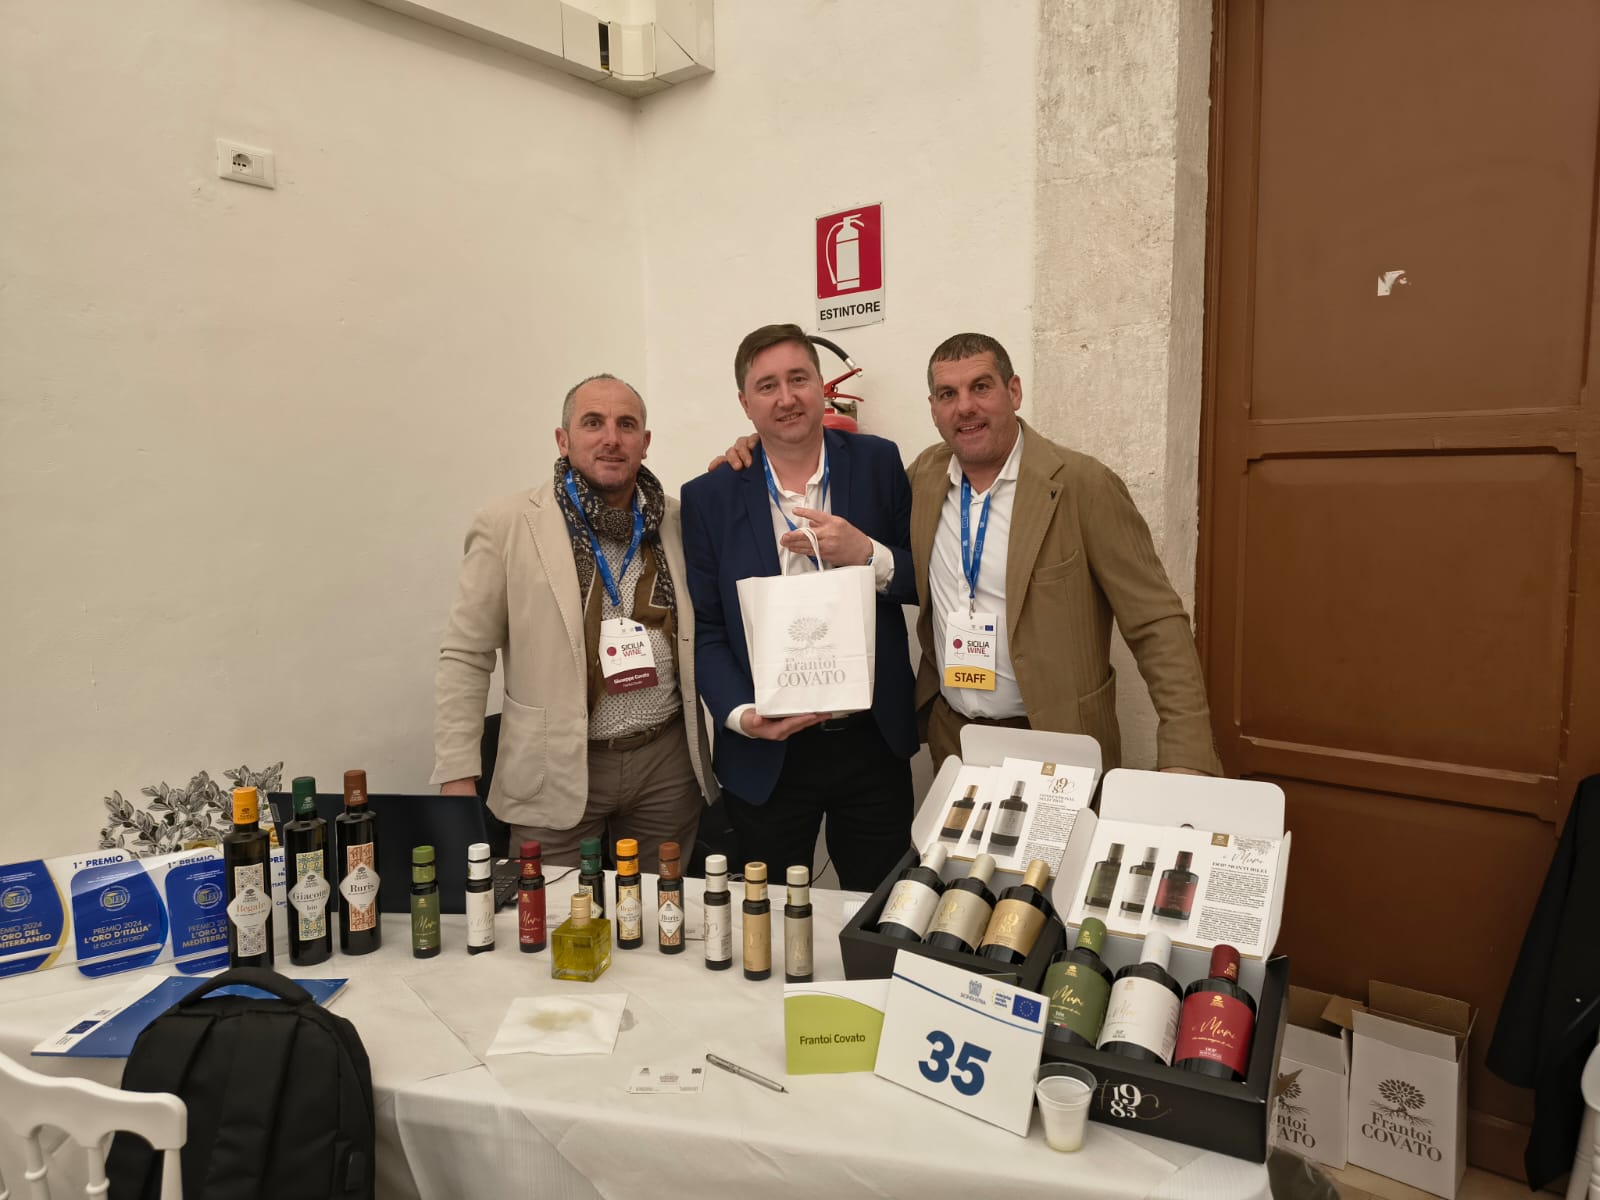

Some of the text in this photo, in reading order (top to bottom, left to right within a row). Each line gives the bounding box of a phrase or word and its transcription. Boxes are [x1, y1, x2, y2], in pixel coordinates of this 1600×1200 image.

[820, 301, 880, 321] ESTINTORE
[621, 641, 645, 651] SICILIA
[966, 640, 990, 648] SICILIA
[623, 649, 642, 657] WINE
[967, 647, 986, 655] WINE
[785, 655, 837, 671] Frantoi
[777, 669, 846, 687] COVATO
[954, 672, 987, 684] STAFF
[85, 855, 123, 867] PREMIO
[179, 854, 215, 865] PREMIO
[0, 921, 43, 934] EMIO 2024
[93, 920, 142, 934] PREMIO 2024
[188, 919, 226, 932] PREMIO 20
[25, 929, 40, 937] DEL
[84, 932, 112, 944] L'ORO
[191, 928, 217, 939] L'ORO
[182, 933, 227, 948] MEDITERRA
[799, 1032, 866, 1046] Frantoi Covato
[918, 1030, 992, 1097] 35
[1277, 1115, 1308, 1132] ntoi
[1371, 1111, 1433, 1145] Frantoi
[1276, 1127, 1316, 1149] ATO
[1361, 1123, 1443, 1163] COVATO
